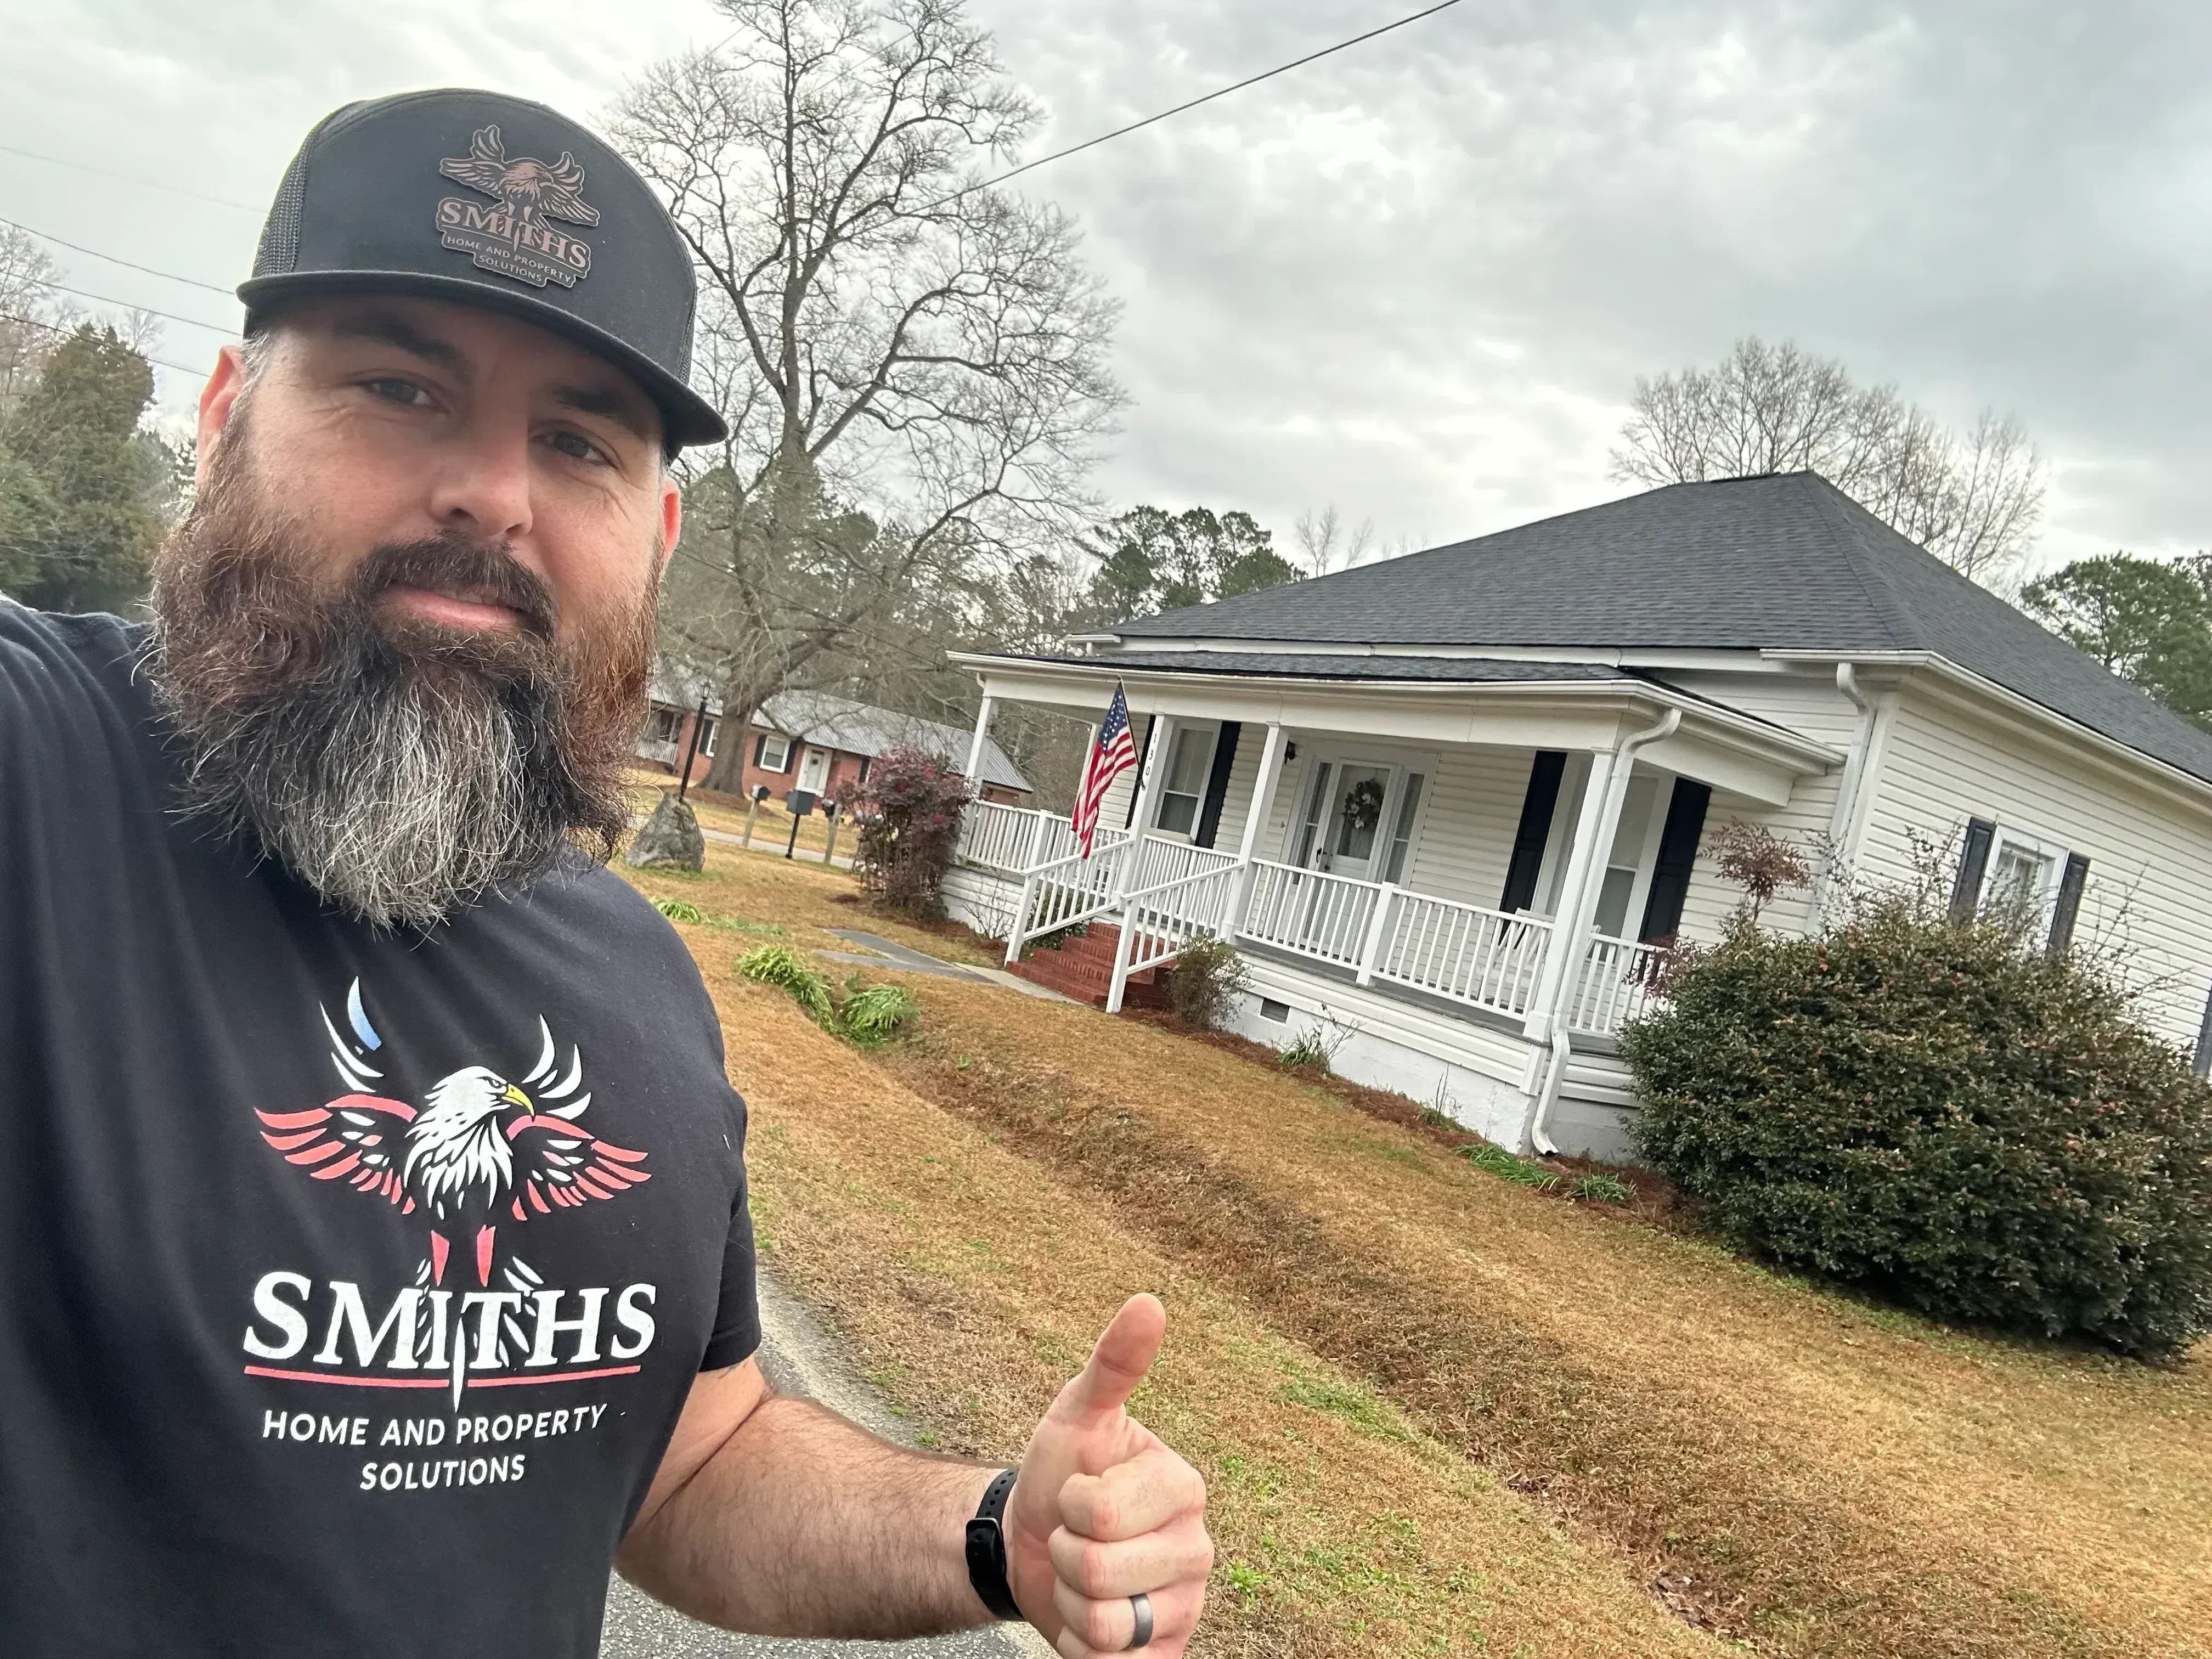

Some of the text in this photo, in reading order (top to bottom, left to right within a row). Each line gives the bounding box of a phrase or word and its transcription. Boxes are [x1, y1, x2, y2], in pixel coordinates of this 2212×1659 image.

[441, 201, 587, 268] SMITHS
[447, 236, 572, 283] HOME AND PROPERTY
[478, 255, 543, 282] SOLUTIONS
[1146, 733, 1157, 776] 130
[242, 1271, 657, 1369] SMITHS
[262, 1403, 607, 1446] HOME AND PROPERTY
[359, 1455, 526, 1491] SOLUTIONS
